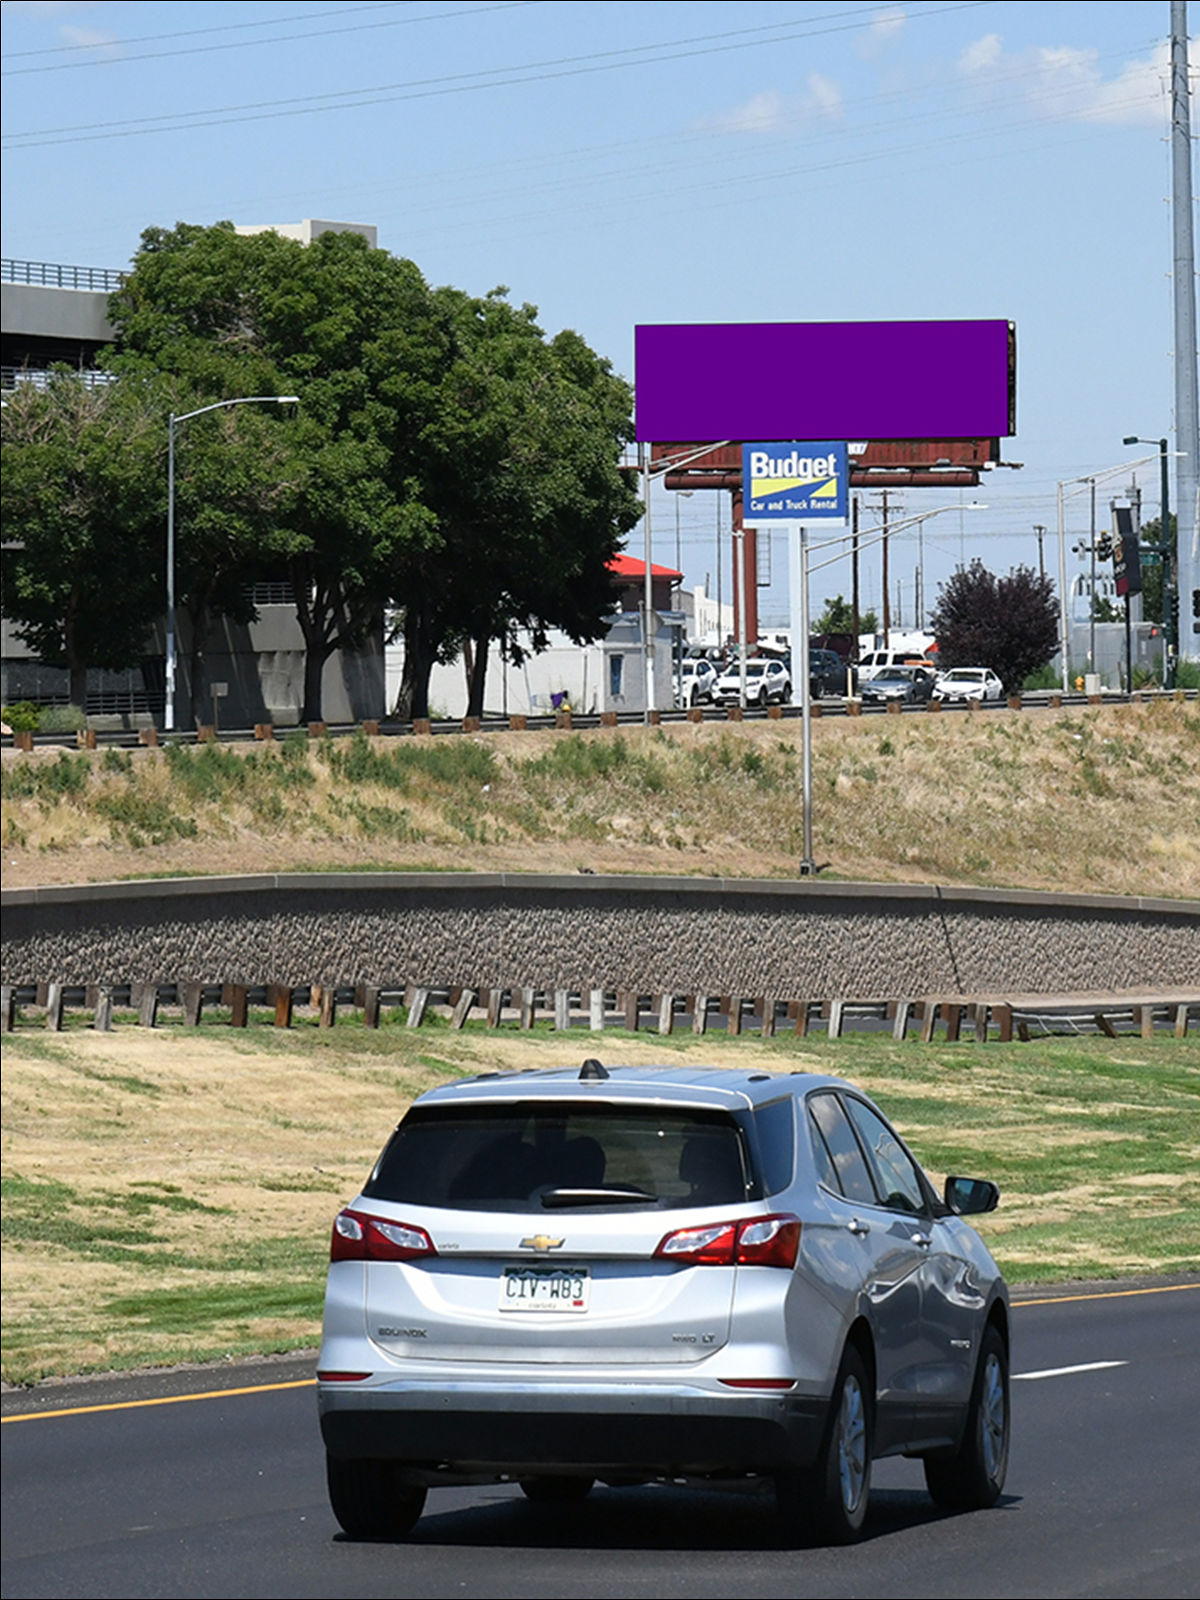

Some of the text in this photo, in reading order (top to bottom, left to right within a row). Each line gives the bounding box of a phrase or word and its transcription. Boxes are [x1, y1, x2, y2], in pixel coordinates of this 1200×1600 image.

[751, 451, 837, 483] Budget
[751, 498, 838, 511] Car and Truck Rental
[378, 1328, 427, 1338] EQUINOX
[702, 1333, 716, 1344] LT
